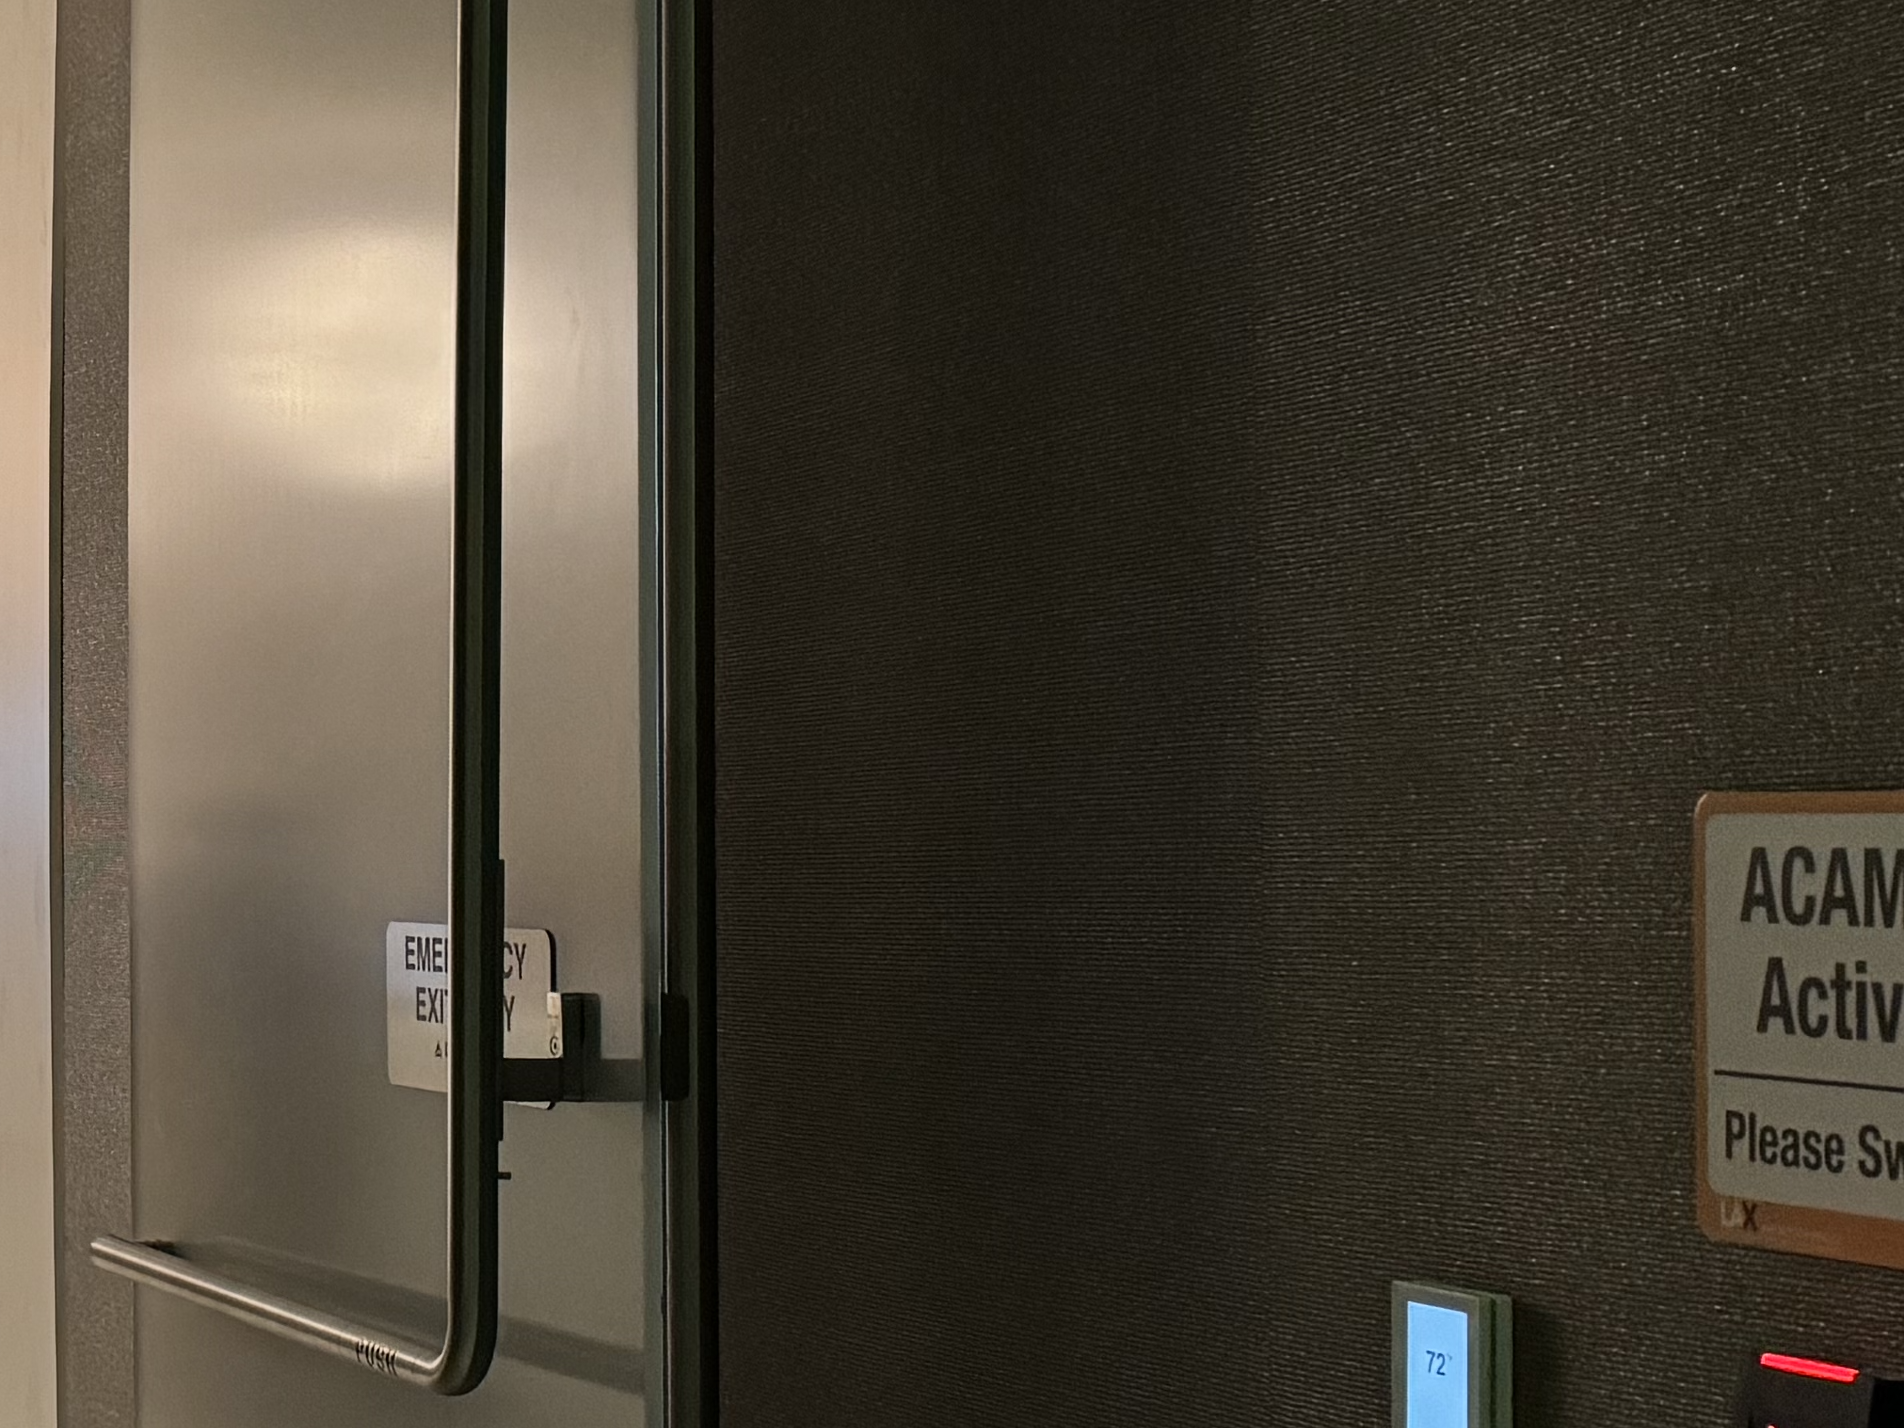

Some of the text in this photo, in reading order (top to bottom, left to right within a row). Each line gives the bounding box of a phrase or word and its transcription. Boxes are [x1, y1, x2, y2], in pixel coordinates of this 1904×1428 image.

[405, 935, 527, 980] EMECY
[1755, 956, 1904, 1044] Activ
[1724, 1109, 1845, 1174] Please
